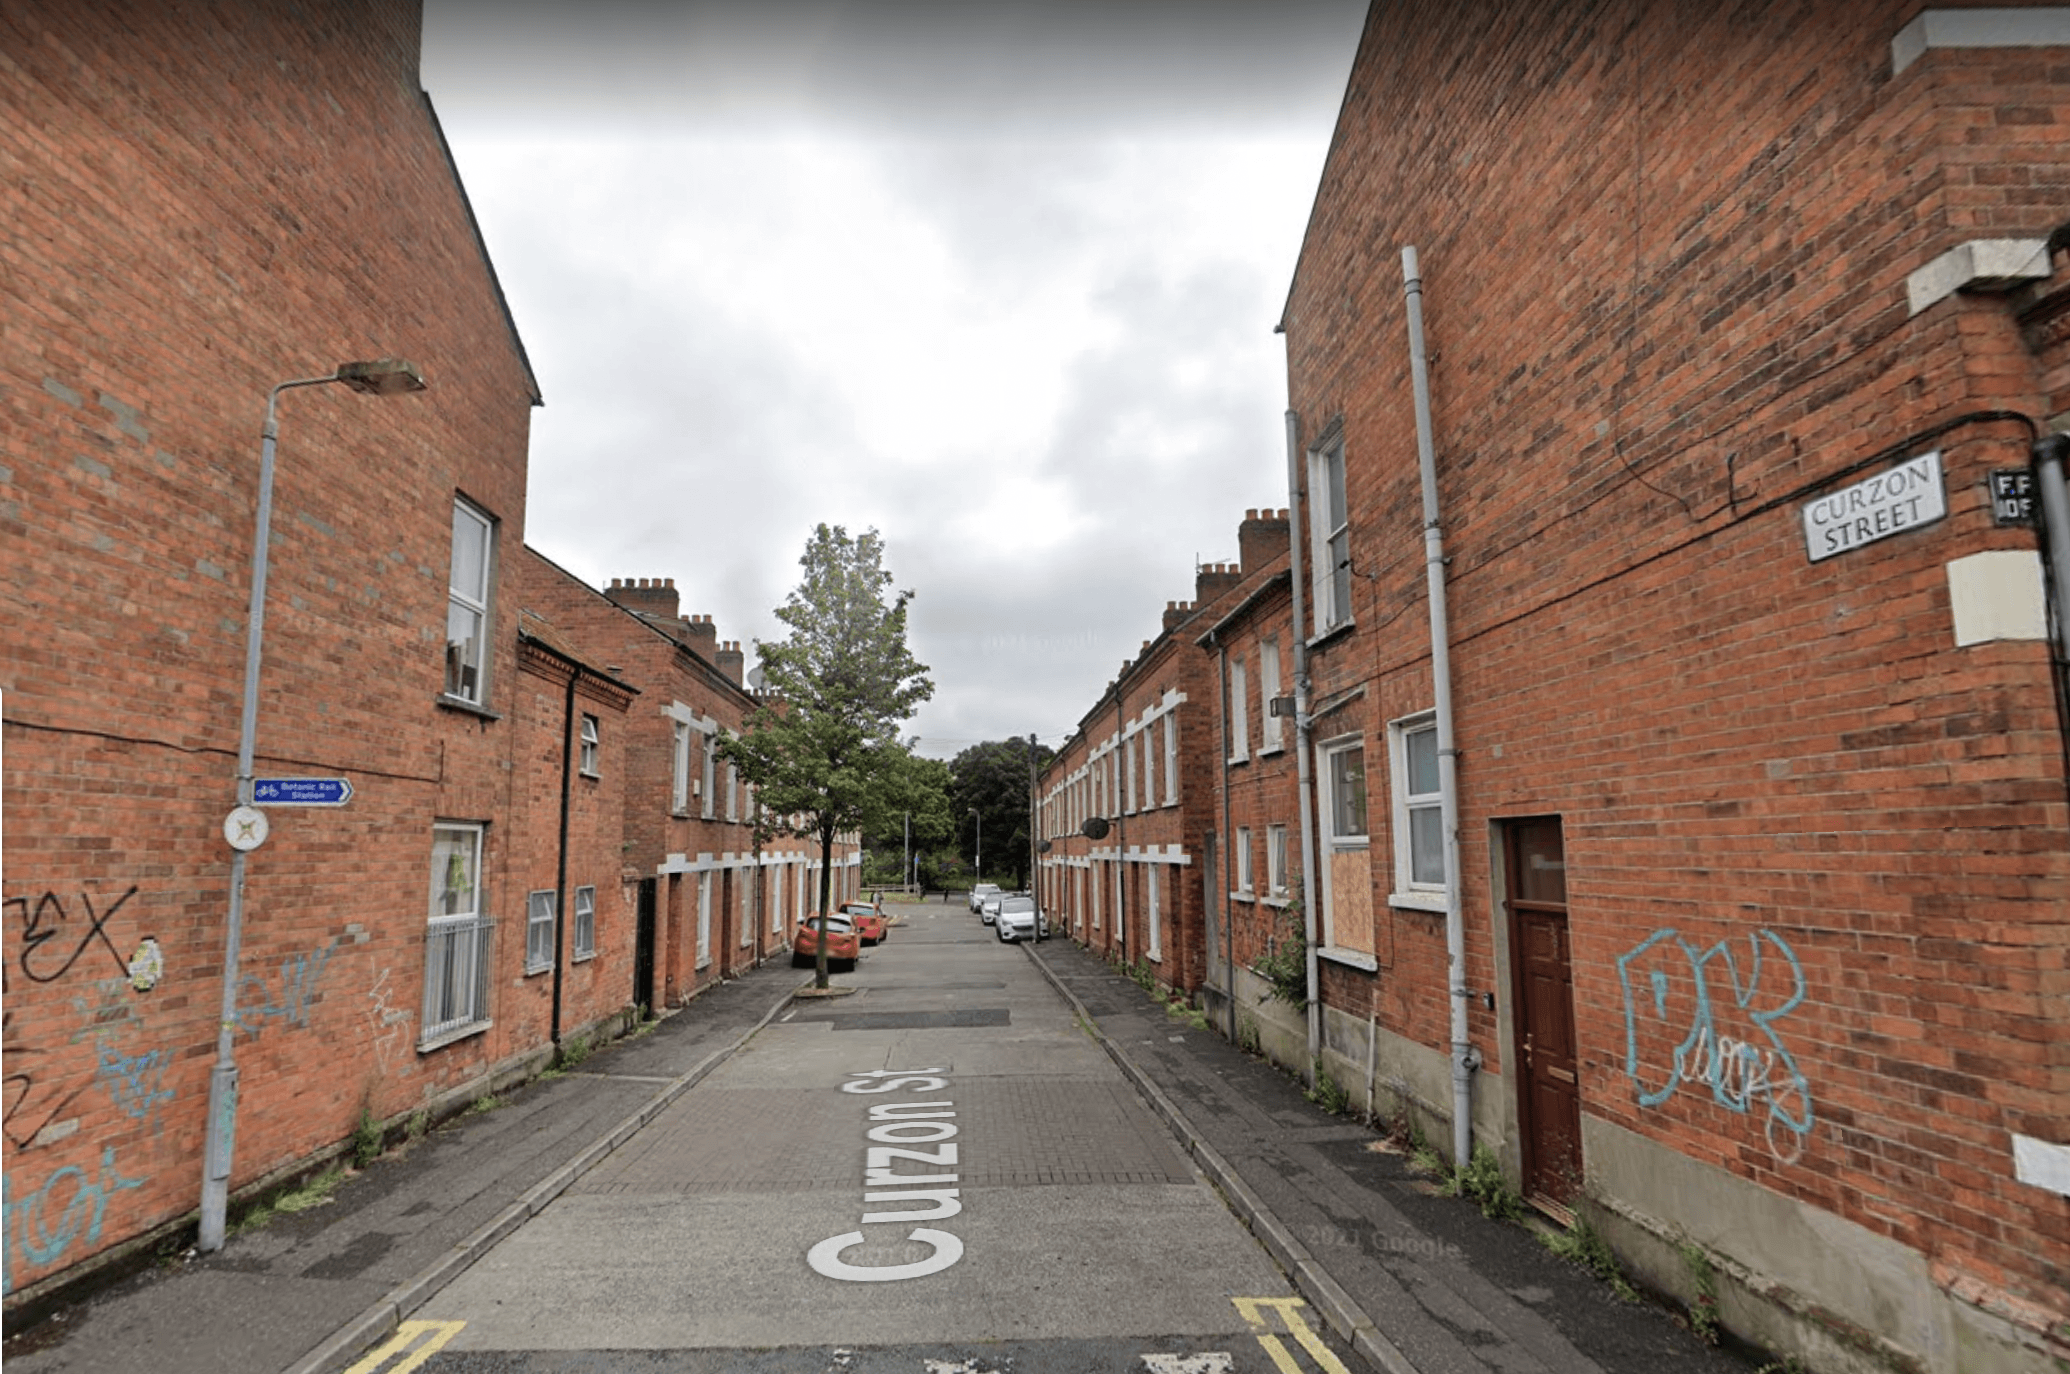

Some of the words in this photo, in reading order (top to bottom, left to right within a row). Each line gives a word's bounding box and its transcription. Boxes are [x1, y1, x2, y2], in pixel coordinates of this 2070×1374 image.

[1812, 460, 1930, 526] CURZON
[1825, 495, 1923, 551] STREET
[838, 1066, 952, 1095] St
[807, 1101, 964, 1282] Curzon
